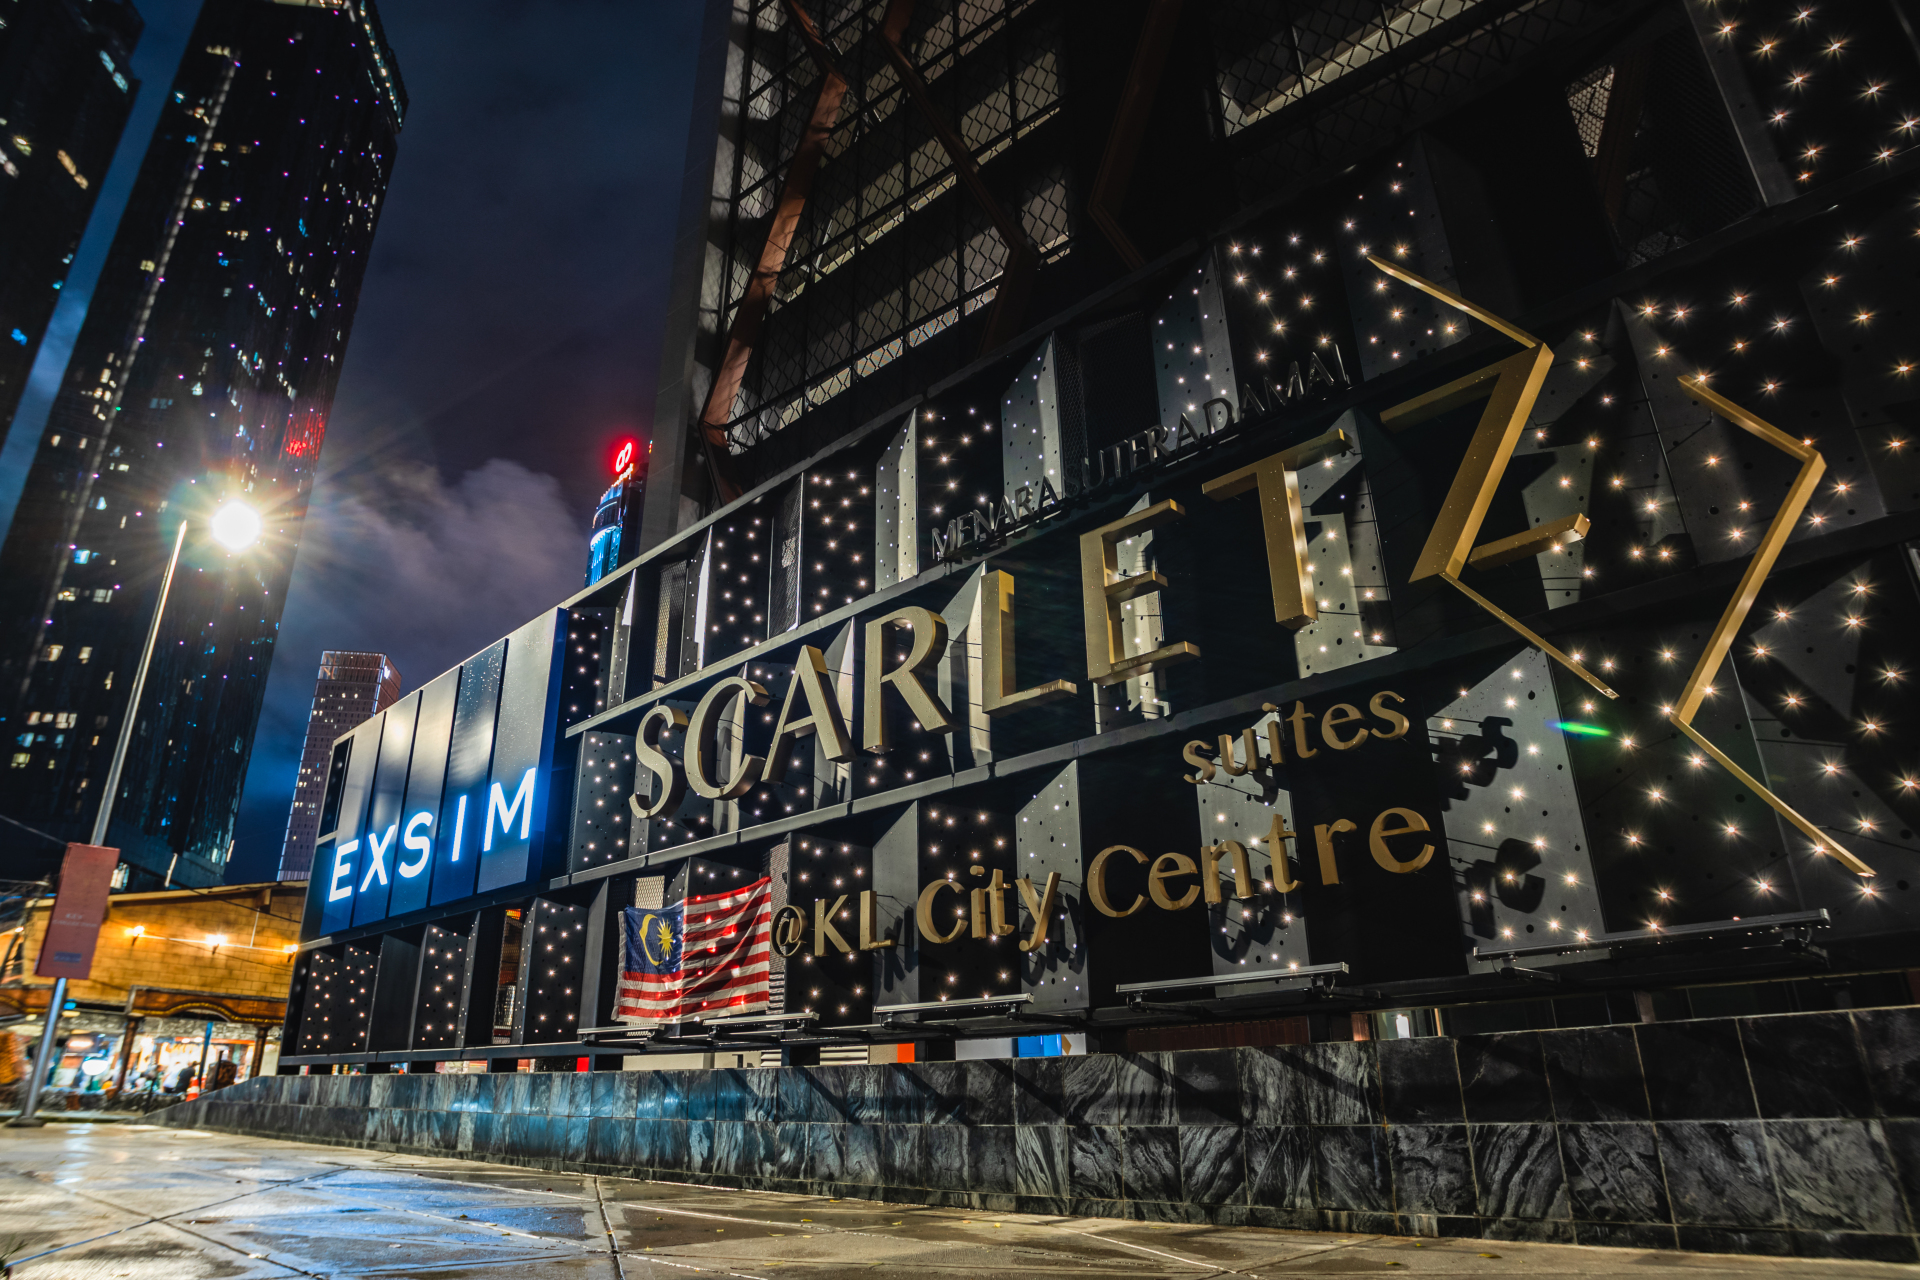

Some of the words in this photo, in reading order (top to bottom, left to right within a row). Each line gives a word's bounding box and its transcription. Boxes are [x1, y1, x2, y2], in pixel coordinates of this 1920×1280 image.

[628, 342, 1591, 820] SCARLETZ
[932, 476, 1059, 560] MENARA
[1183, 689, 1410, 784] suites
[327, 766, 537, 903] EXSIM
[770, 890, 896, 959] @KL
[916, 865, 1061, 952] City
[1087, 806, 1435, 918] Centre
